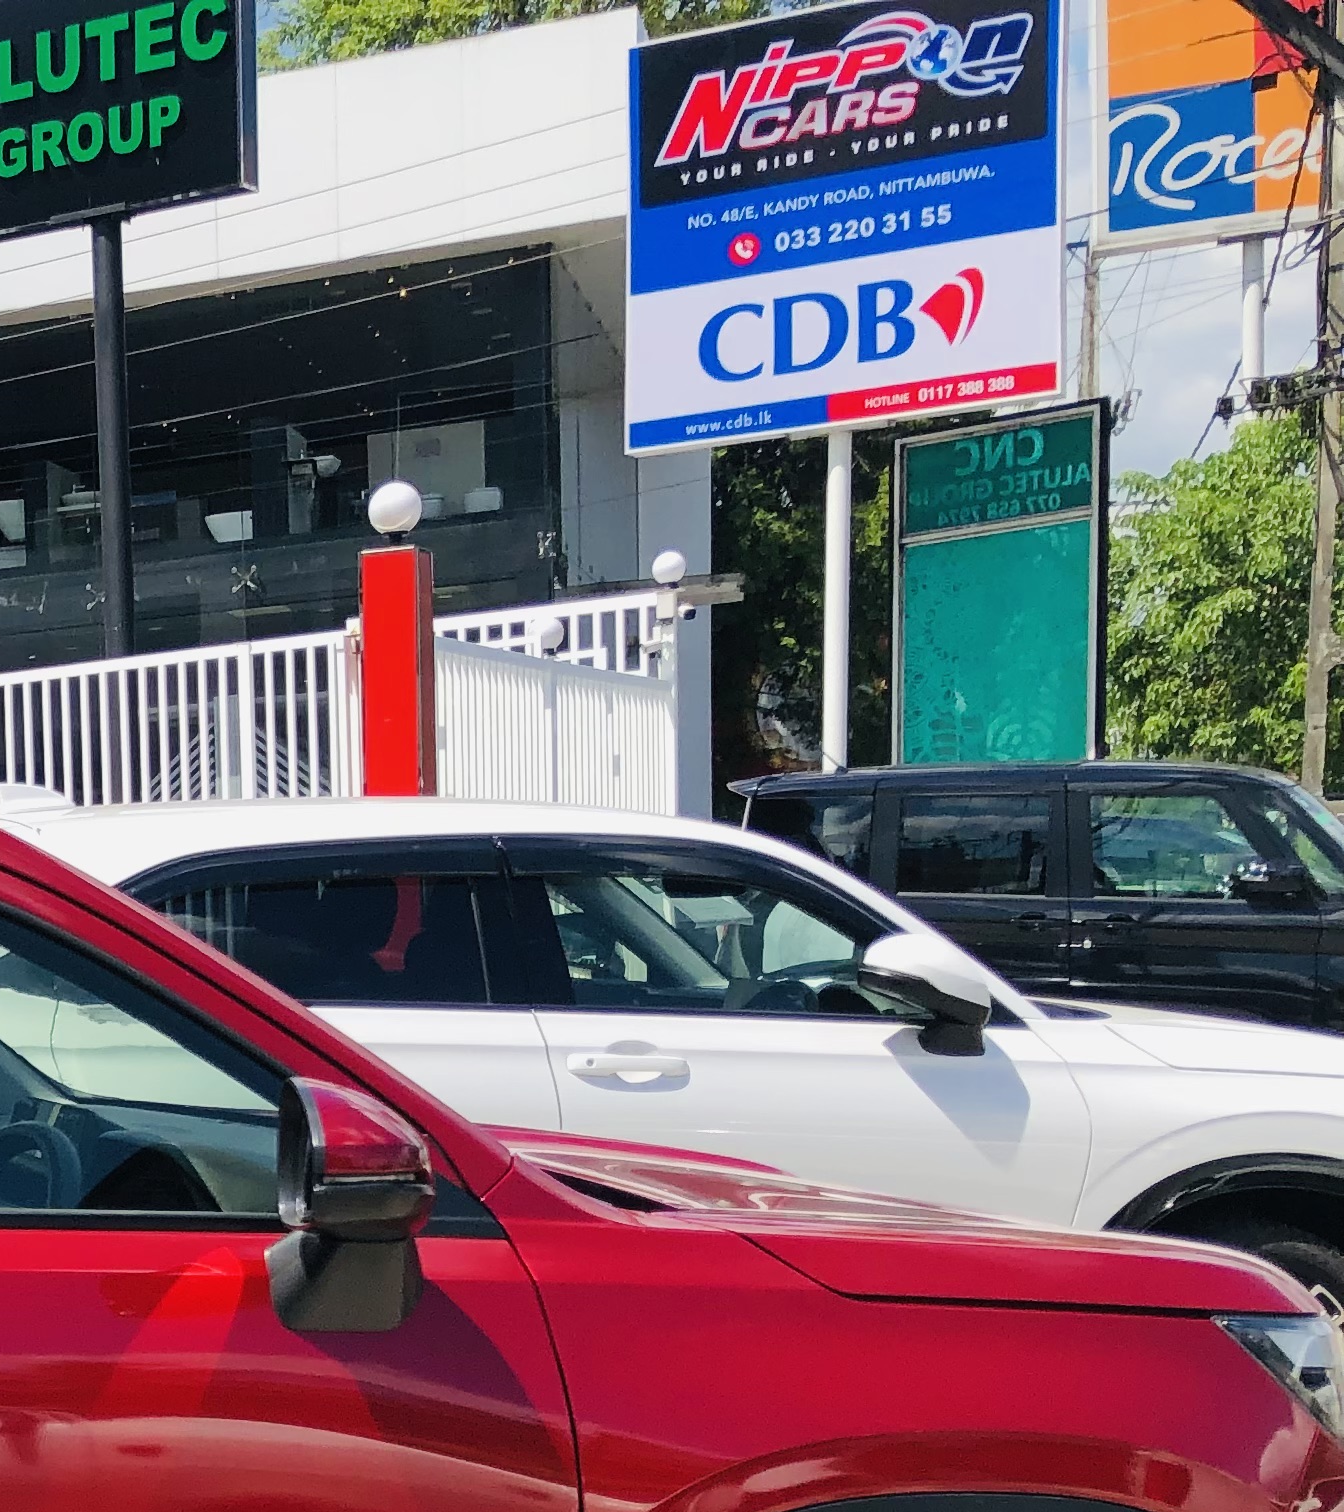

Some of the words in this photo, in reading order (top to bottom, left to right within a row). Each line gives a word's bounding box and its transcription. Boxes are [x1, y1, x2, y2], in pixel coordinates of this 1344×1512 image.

[739, 82, 920, 150] CARS
[680, 163, 742, 186] YOUR
[756, 150, 814, 174] RIDE
[851, 131, 915, 155] YOUR
[930, 114, 1009, 142] PRIDE
[687, 214, 717, 230] NO.
[720, 206, 759, 224] 48/E,
[763, 195, 820, 217] KANDY
[823, 185, 875, 207] ROAD,
[774, 228, 821, 253] 033
[827, 218, 875, 244] 220
[882, 209, 912, 233] 31
[920, 203, 953, 228] 55
[698, 279, 916, 384] CDB
[864, 392, 911, 410] HOTLINE
[917, 386, 954, 404] 0117
[685, 410, 773, 437] www.cdb.lk
